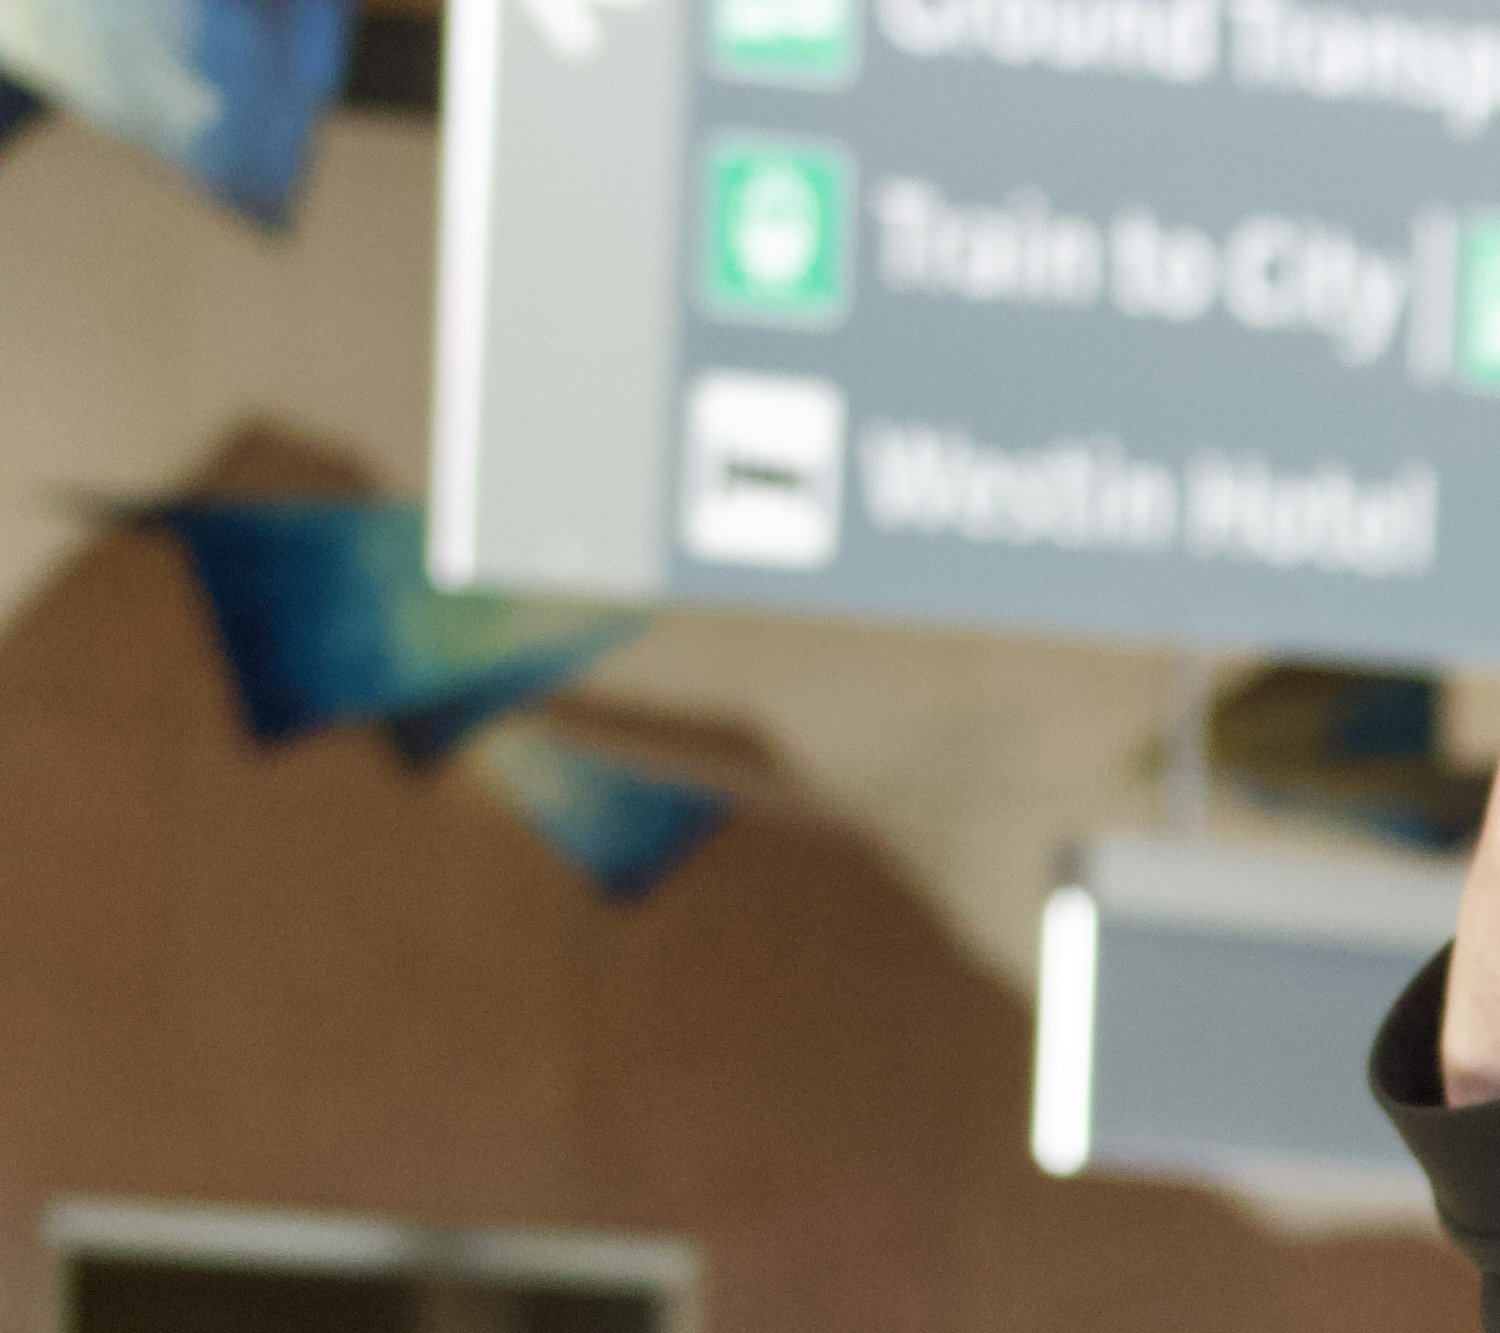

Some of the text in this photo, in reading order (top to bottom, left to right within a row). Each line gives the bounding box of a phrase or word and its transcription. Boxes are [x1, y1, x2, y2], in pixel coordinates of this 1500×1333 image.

[874, 178, 1399, 366] Train to City
[857, 418, 1437, 576] Westin Hotel
